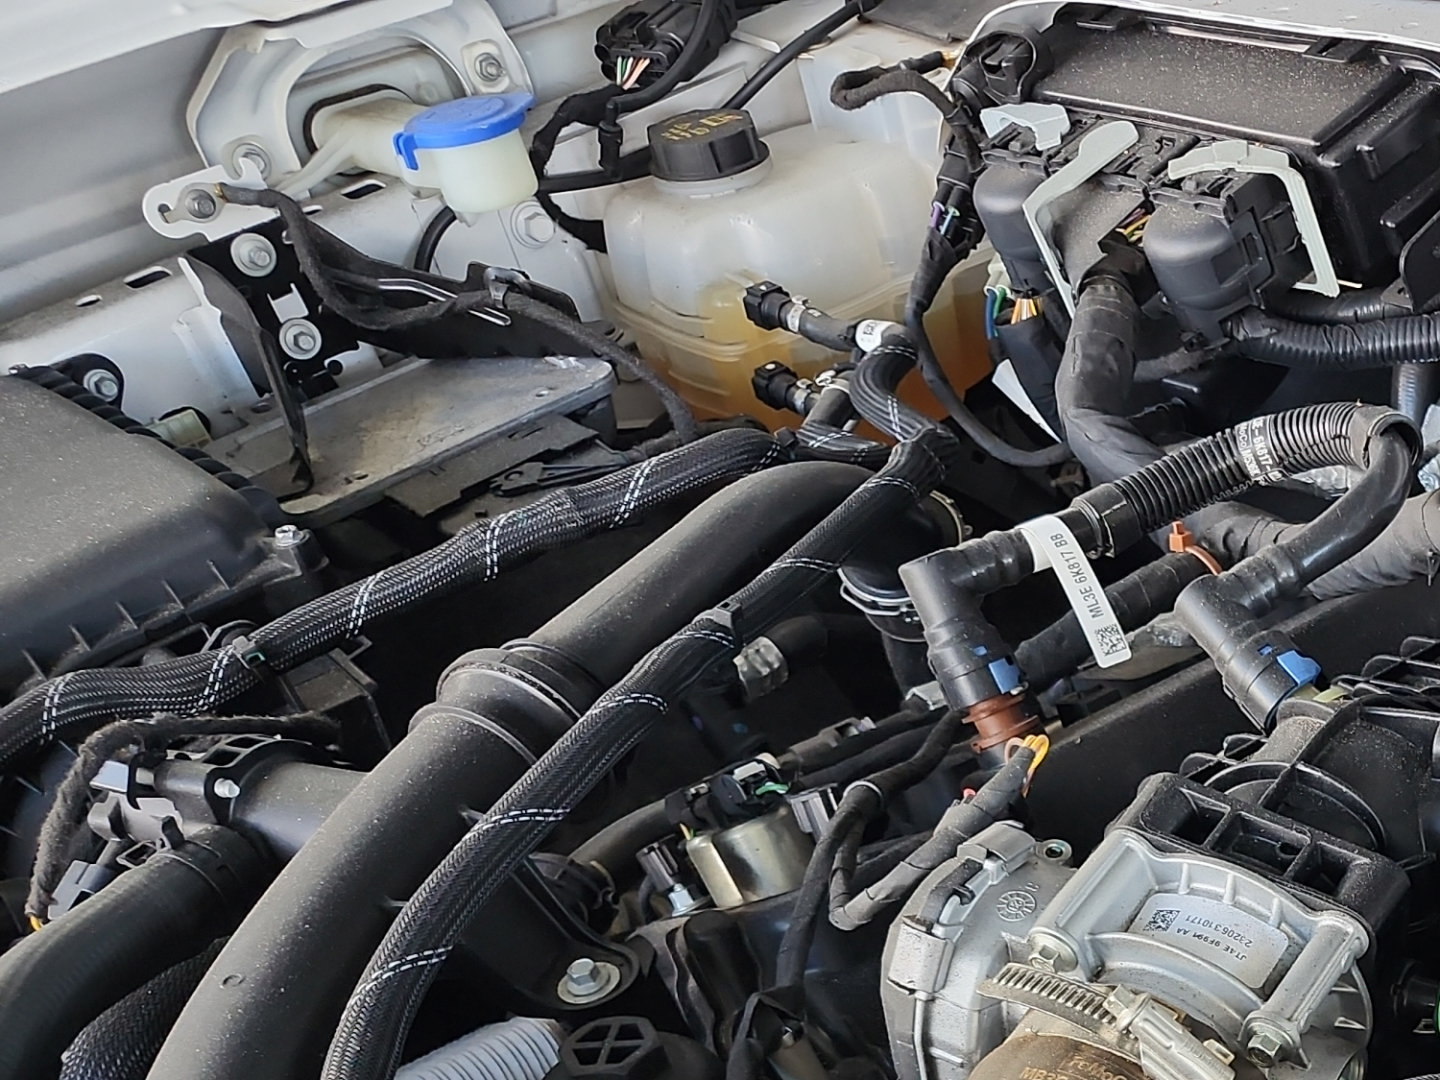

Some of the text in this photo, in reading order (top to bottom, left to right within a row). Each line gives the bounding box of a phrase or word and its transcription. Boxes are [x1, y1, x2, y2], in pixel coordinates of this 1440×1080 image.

[1050, 532, 1105, 619] ML3E 6K817 BB
